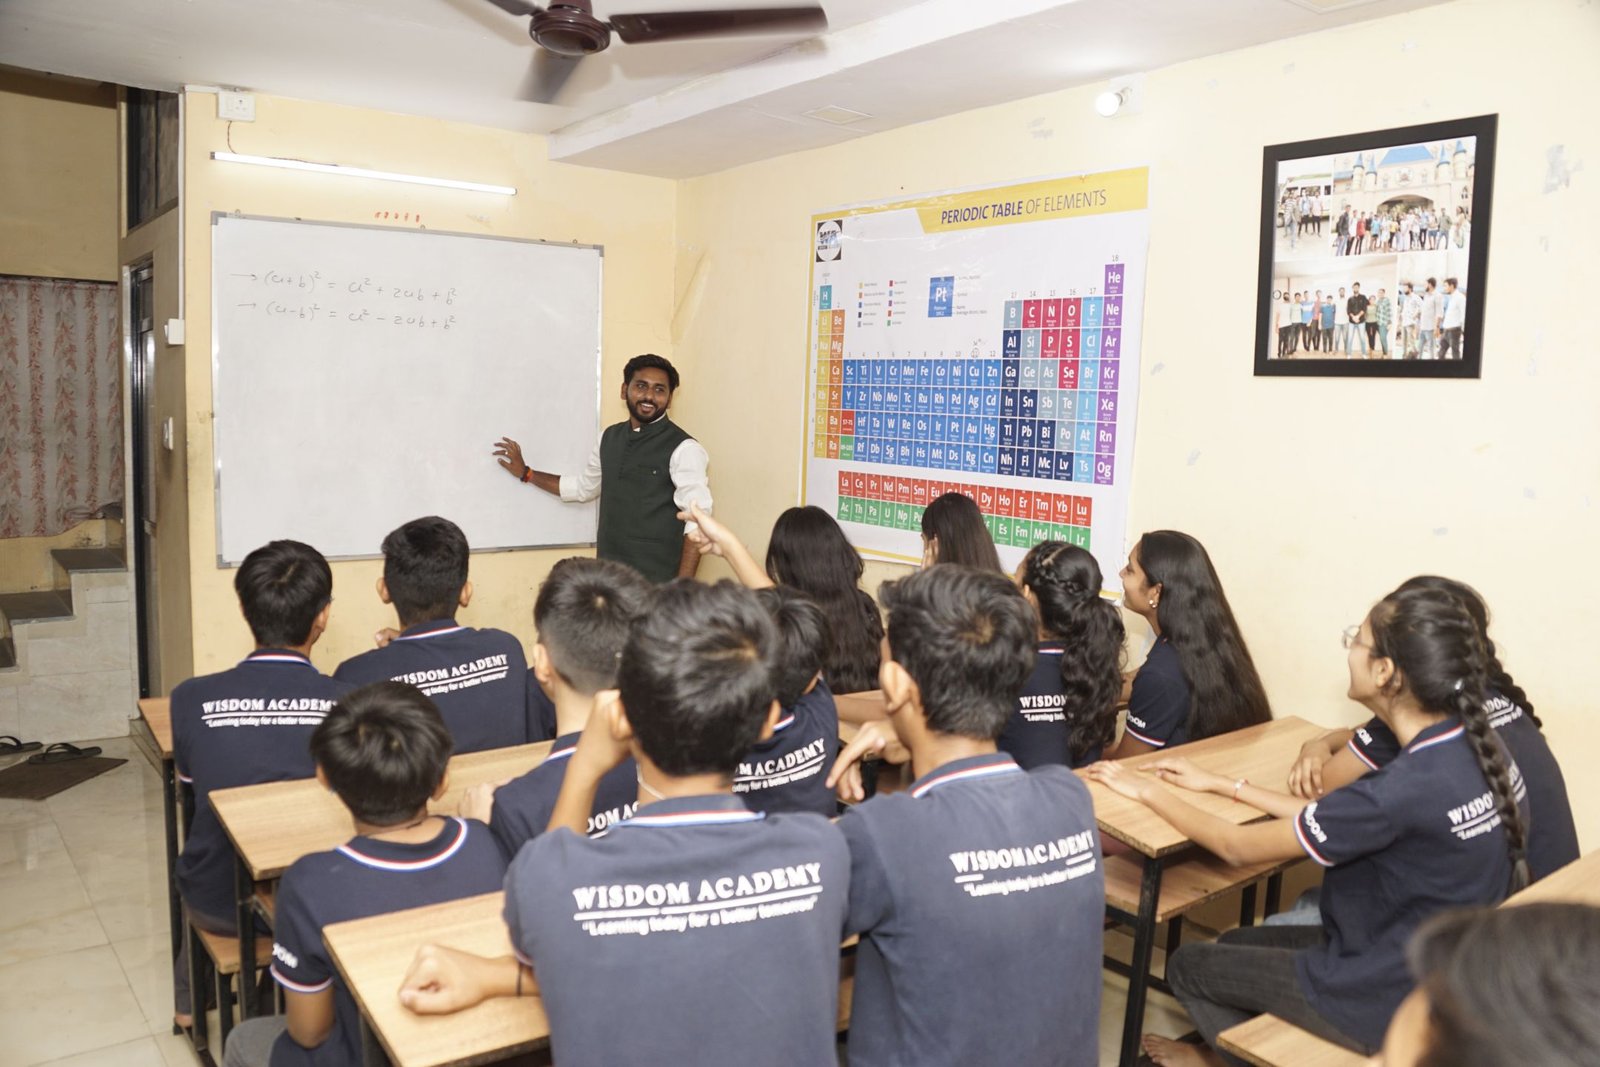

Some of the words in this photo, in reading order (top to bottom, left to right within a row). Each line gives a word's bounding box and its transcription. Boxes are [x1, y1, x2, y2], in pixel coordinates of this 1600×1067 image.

[941, 205, 989, 224] PERIODIC
[991, 200, 1023, 218] TABLE
[1026, 199, 1041, 214] OF
[1043, 188, 1107, 213] ELEMENTS
[1108, 271, 1121, 283] He
[935, 288, 947, 302] Pt
[1010, 307, 1016, 318] B
[1029, 306, 1035, 318] C
[1048, 306, 1055, 317] N
[1068, 305, 1075, 316] O
[1090, 304, 1095, 316] F
[1106, 303, 1119, 315] Ne
[832, 340, 842, 354] Mg
[1007, 336, 1016, 348] Al
[1027, 336, 1034, 348] Si
[1048, 336, 1053, 347] P
[1067, 336, 1072, 348] S
[1087, 335, 1095, 347] Cl
[1105, 336, 1116, 347] Ar
[831, 366, 840, 375] Ca
[846, 366, 853, 375] Sc
[861, 366, 867, 375] Ti
[875, 366, 882, 375] V
[890, 366, 898, 375] Cr
[903, 366, 915, 376] Mn
[921, 366, 929, 376] Fe
[936, 366, 945, 376] Co
[953, 366, 962, 376] Ni
[969, 366, 980, 376] Cu
[987, 367, 998, 377] Zn
[1005, 367, 1016, 377] Ga
[1024, 366, 1035, 377] Ge
[1043, 367, 1054, 378] As
[1064, 367, 1074, 378] Se
[1084, 367, 1093, 378] Br
[1104, 367, 1115, 379] Kr
[832, 391, 838, 399] Sr
[846, 391, 851, 399] Y
[859, 392, 867, 401] Zr
[872, 392, 882, 401] Nb
[887, 393, 898, 402] Mo
[904, 394, 911, 402] Tc
[918, 394, 928, 403] Ru
[934, 393, 944, 403] Rh
[951, 394, 961, 404] Pd
[968, 395, 979, 408] Ag
[986, 395, 996, 405] Cd
[1005, 396, 1013, 406] In
[1023, 396, 1034, 408] Sn
[1042, 397, 1053, 408] Sb
[1063, 397, 1072, 409] Te
[1085, 397, 1088, 408] I
[1101, 398, 1114, 410] Xe
[830, 417, 838, 426] Ba
[858, 417, 866, 426] Hf
[872, 418, 880, 428] Ta
[887, 418, 895, 428] W
[902, 419, 911, 430] Re
[917, 421, 927, 430] Os
[935, 421, 942, 431] Ir
[951, 422, 960, 433] Pt
[967, 423, 977, 433] Au
[984, 424, 995, 438] Hg
[1004, 425, 1012, 436] Tl
[1022, 426, 1032, 437] Pb
[1042, 427, 1051, 438] Bi
[1060, 428, 1070, 440] Po
[1080, 429, 1090, 441] At
[1100, 430, 1112, 442] Rn
[829, 441, 837, 450] Ra
[857, 442, 865, 452] Rf
[871, 445, 880, 454] Db
[886, 445, 894, 458] Sg
[901, 446, 910, 456] Bh
[916, 448, 925, 457] Hs
[932, 448, 943, 459] Mt
[949, 450, 959, 460] Ds
[966, 451, 976, 465] Rg
[983, 453, 993, 464] Cn
[1001, 454, 1012, 465] Nh
[1022, 455, 1029, 466] Fl
[1038, 457, 1051, 469] Mc
[1059, 458, 1069, 470] Lv
[1080, 460, 1088, 472] Ts
[1098, 462, 1111, 477] Og
[841, 478, 849, 487] La
[855, 479, 863, 489] Ce
[870, 480, 877, 490] Pr
[883, 481, 894, 492] Nd
[898, 482, 910, 494] Pm
[913, 485, 925, 496] Sm
[931, 486, 939, 498] Eu
[981, 492, 992, 507] Dy
[999, 494, 1011, 506] Ho
[1019, 495, 1028, 507] Er
[1036, 498, 1049, 510] Tm
[1056, 500, 1067, 513] Yb
[1076, 502, 1087, 515] Lu
[841, 503, 848, 512] Ac
[855, 504, 863, 514] Th
[869, 505, 877, 516] Pa
[885, 507, 890, 518] U
[897, 509, 907, 523] Np
[999, 523, 1007, 535] Es
[1016, 524, 1028, 538] Fm
[1034, 527, 1048, 541] Md
[1076, 534, 1085, 545] Lr
[451, 654, 507, 677] ACADEMY
[202, 698, 266, 714] WISDOM
[266, 698, 337, 712] ACADEM
[754, 737, 825, 777] ACADEMY
[949, 847, 1026, 874] WISDOM
[1024, 829, 1094, 866] ACADEMY
[572, 881, 692, 911] WISDOM
[696, 862, 822, 902] ACADEMY
[688, 911, 709, 928] for
[720, 905, 759, 925] better
